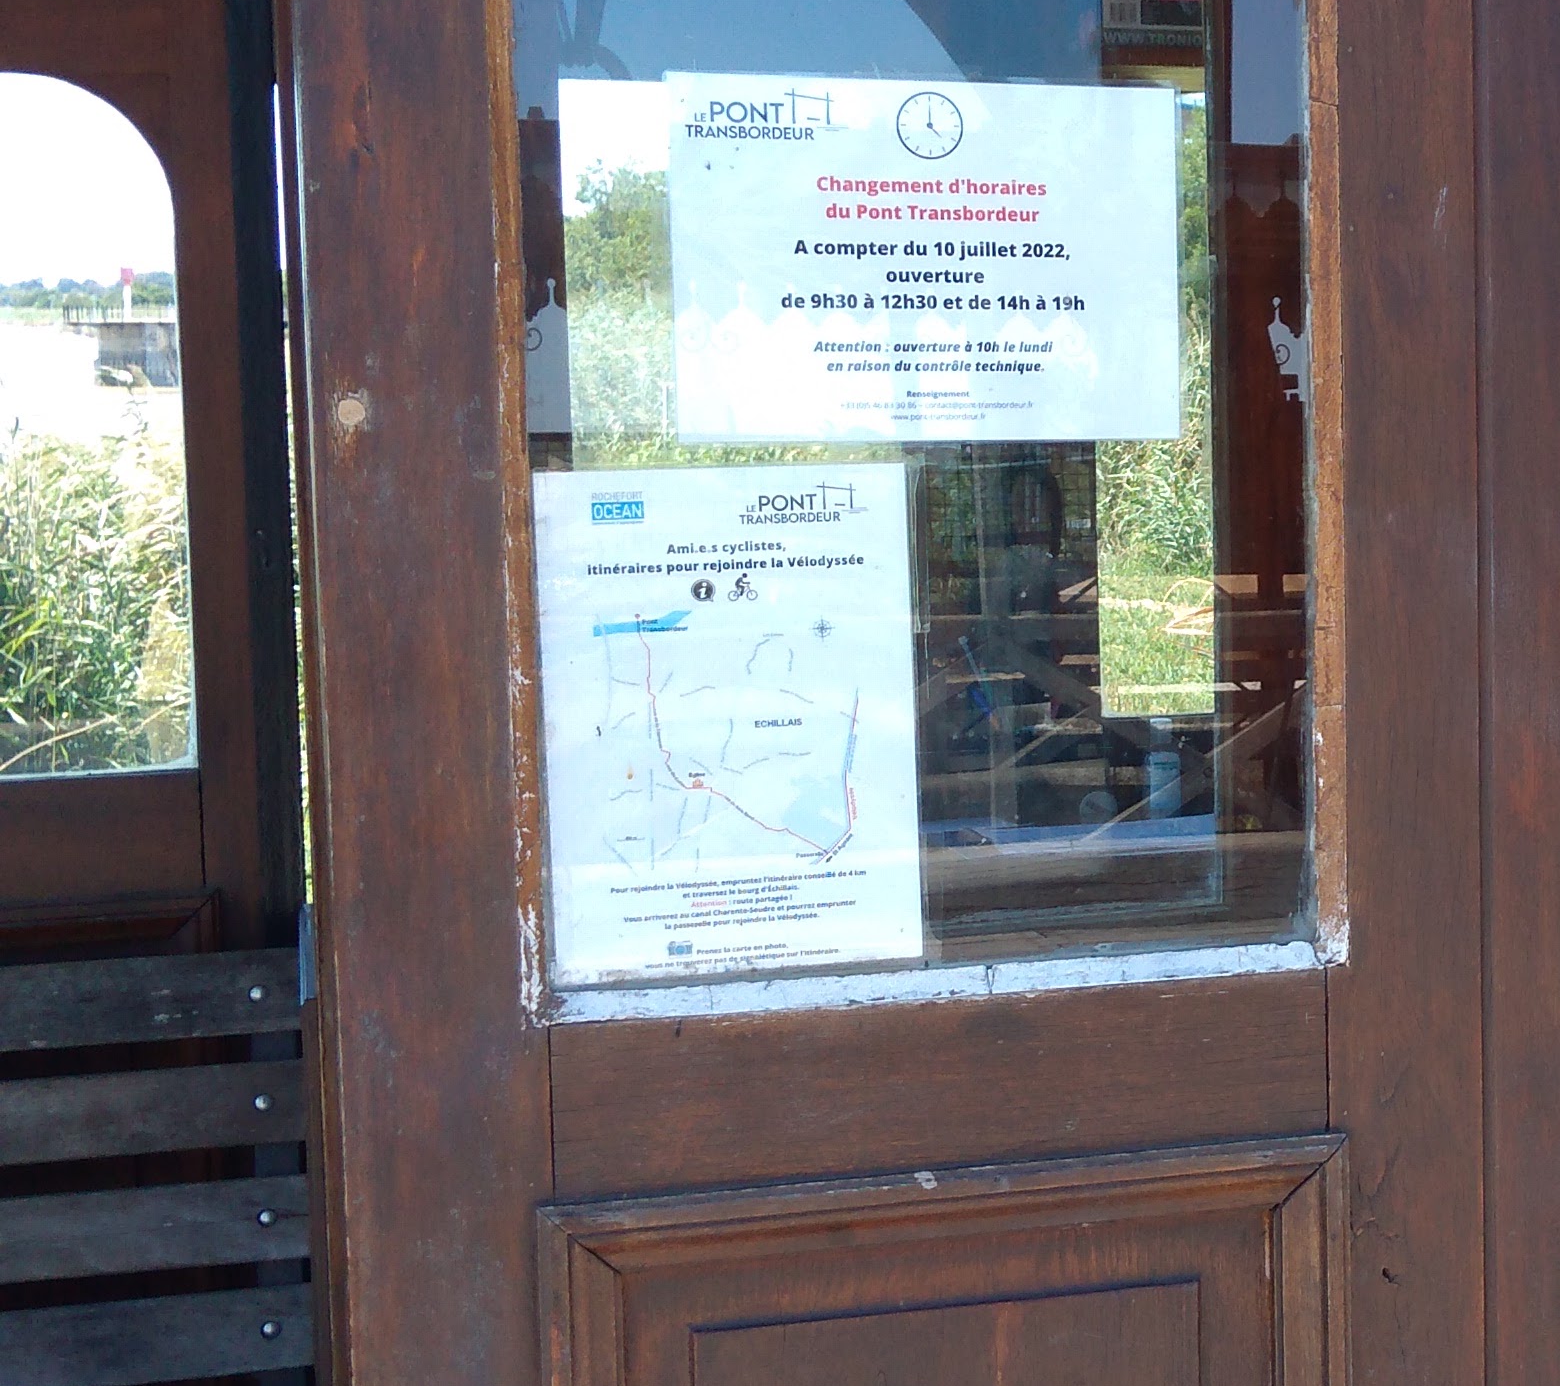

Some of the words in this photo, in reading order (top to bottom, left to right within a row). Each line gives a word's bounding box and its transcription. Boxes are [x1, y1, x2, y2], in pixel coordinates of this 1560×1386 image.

[694, 112, 706, 123] LE
[709, 101, 785, 125] PONT
[685, 124, 815, 141] TRANSBORDEUR
[816, 176, 944, 196] Changement
[948, 178, 1047, 196] d'horaires
[825, 203, 850, 219] du
[856, 204, 902, 220] Pont
[907, 205, 1040, 222] Transbordeur
[794, 239, 808, 254] A
[813, 242, 898, 260] compter
[903, 240, 927, 256] du
[933, 241, 955, 256] 10
[959, 241, 1018, 261] juillet
[1022, 243, 1071, 260] 2022,
[886, 269, 985, 284] ouverture
[781, 293, 806, 309] de
[810, 293, 858, 309] 9h30
[863, 292, 875, 309] à
[881, 294, 937, 310] 12h30
[942, 295, 963, 310] et
[968, 294, 991, 310] de
[997, 295, 1030, 311] 14h
[1035, 294, 1046, 310] à
[1052, 295, 1085, 311] 19h
[814, 340, 882, 353] Attention
[893, 342, 961, 353] ouverture
[964, 341, 973, 353] à
[976, 341, 1000, 353] 10h
[1003, 341, 1016, 353] le
[1019, 341, 1053, 353] lundi
[826, 362, 844, 373] en
[847, 360, 891, 373] raison
[894, 360, 911, 373] du
[915, 360, 972, 373] contrôle
[975, 360, 1045, 375] technique.
[906, 390, 970, 399] Renseignement
[896, 401, 907, 410] 30
[907, 401, 918, 410] 86
[590, 491, 643, 501] ROCHEFORT
[746, 504, 757, 513] LE
[758, 493, 817, 512] PONT
[739, 511, 841, 525] TRANSBORDEUR
[666, 541, 718, 555] Ami.e.s
[722, 540, 787, 555] cyclistes,
[587, 562, 662, 576] itinéraires
[666, 562, 699, 576] pour
[703, 557, 767, 573] rejoindre
[771, 556, 784, 568] la
[787, 554, 865, 570] Vélodyssée
[610, 886, 629, 894] Pour
[630, 883, 666, 894] rejoindre
[667, 882, 674, 890] la
[720, 876, 762, 887] empruntez
[854, 868, 867, 877] km
[692, 889, 728, 898] traversez
[728, 887, 736, 895] le
[737, 886, 760, 896] bourg
[690, 899, 728, 909] Attention
[732, 896, 754, 905] route
[755, 894, 789, 905] partagée
[623, 916, 643, 924] Vous
[679, 912, 690, 920] au
[690, 909, 712, 918] canal
[776, 904, 785, 912] et
[816, 899, 857, 910] emprunter
[664, 923, 672, 931] la
[712, 918, 732, 928] pour
[732, 915, 768, 927] rejoindre
[768, 914, 776, 922] la
[696, 947, 722, 956] Prenez
[723, 946, 731, 954] la
[731, 945, 753, 954] carte
[713, 956, 727, 965] pas
[786, 950, 799, 958] sur
